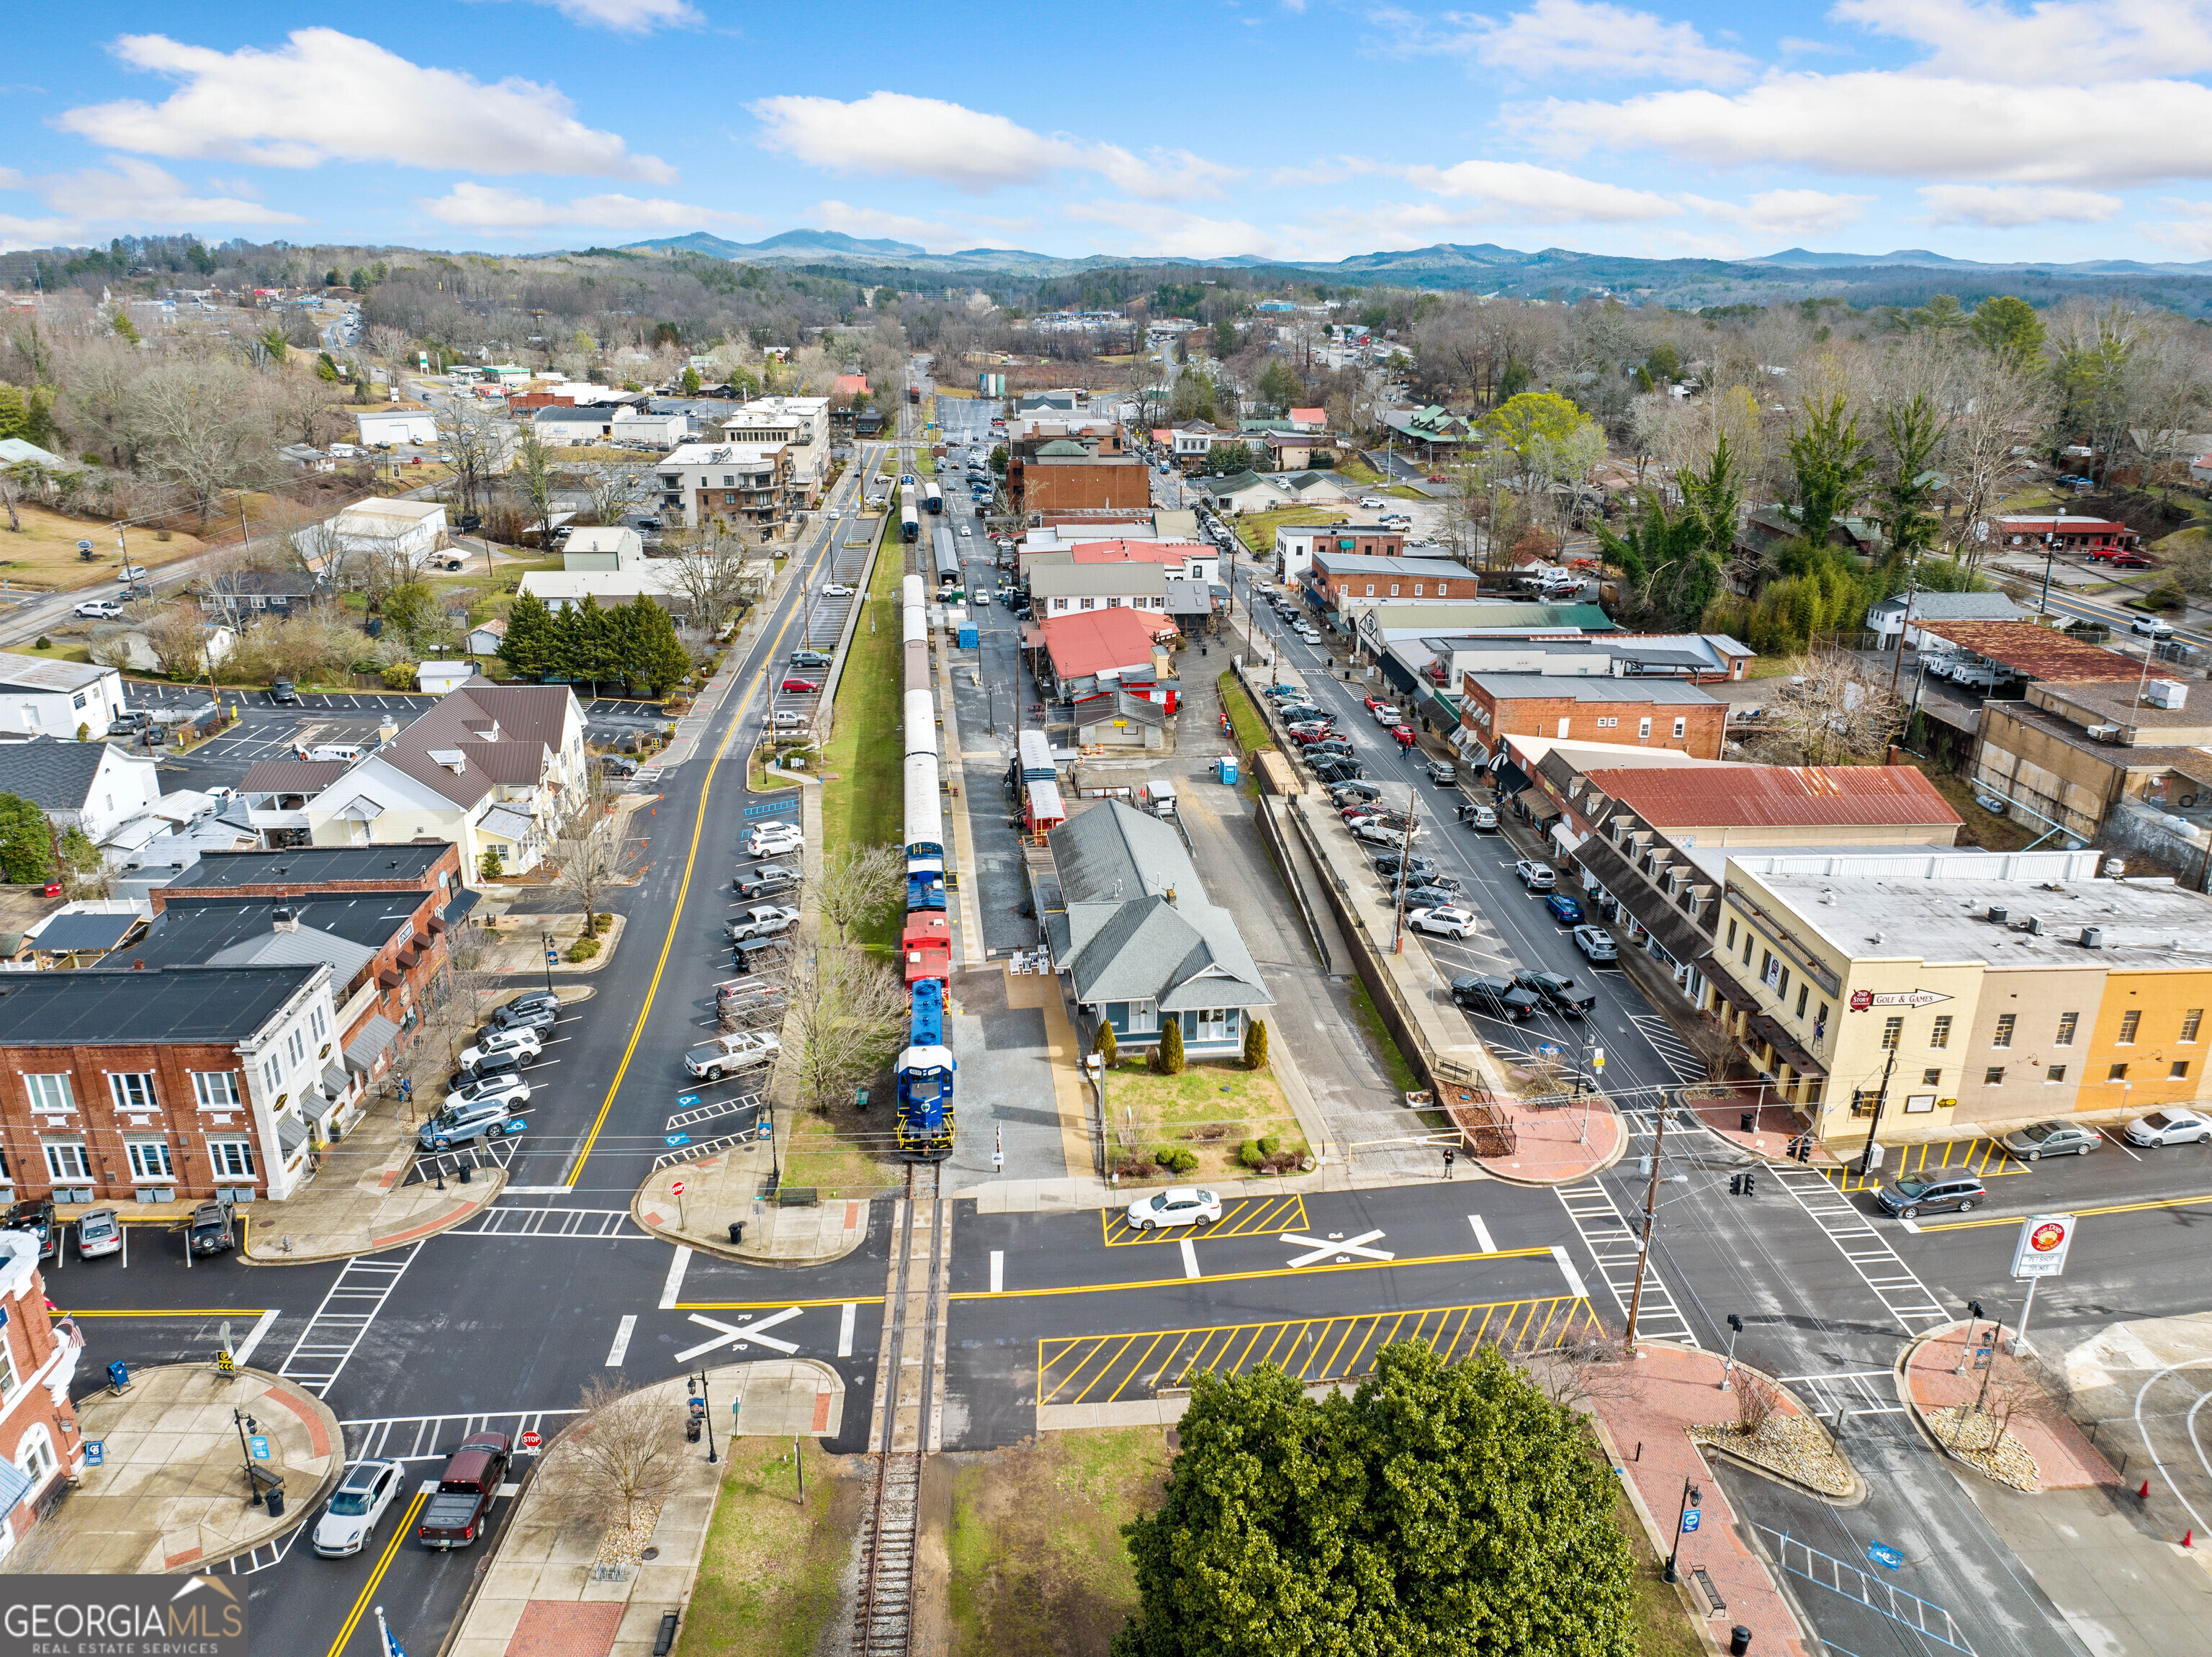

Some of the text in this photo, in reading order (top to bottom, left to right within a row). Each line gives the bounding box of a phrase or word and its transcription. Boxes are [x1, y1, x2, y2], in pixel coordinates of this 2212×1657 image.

[1876, 995, 1896, 1004] GOLF
[1899, 994, 1905, 1003] &
[672, 1184, 684, 1194] STOP
[2033, 1224, 2063, 1239] Love Dogs
[522, 1435, 541, 1444] STOP
